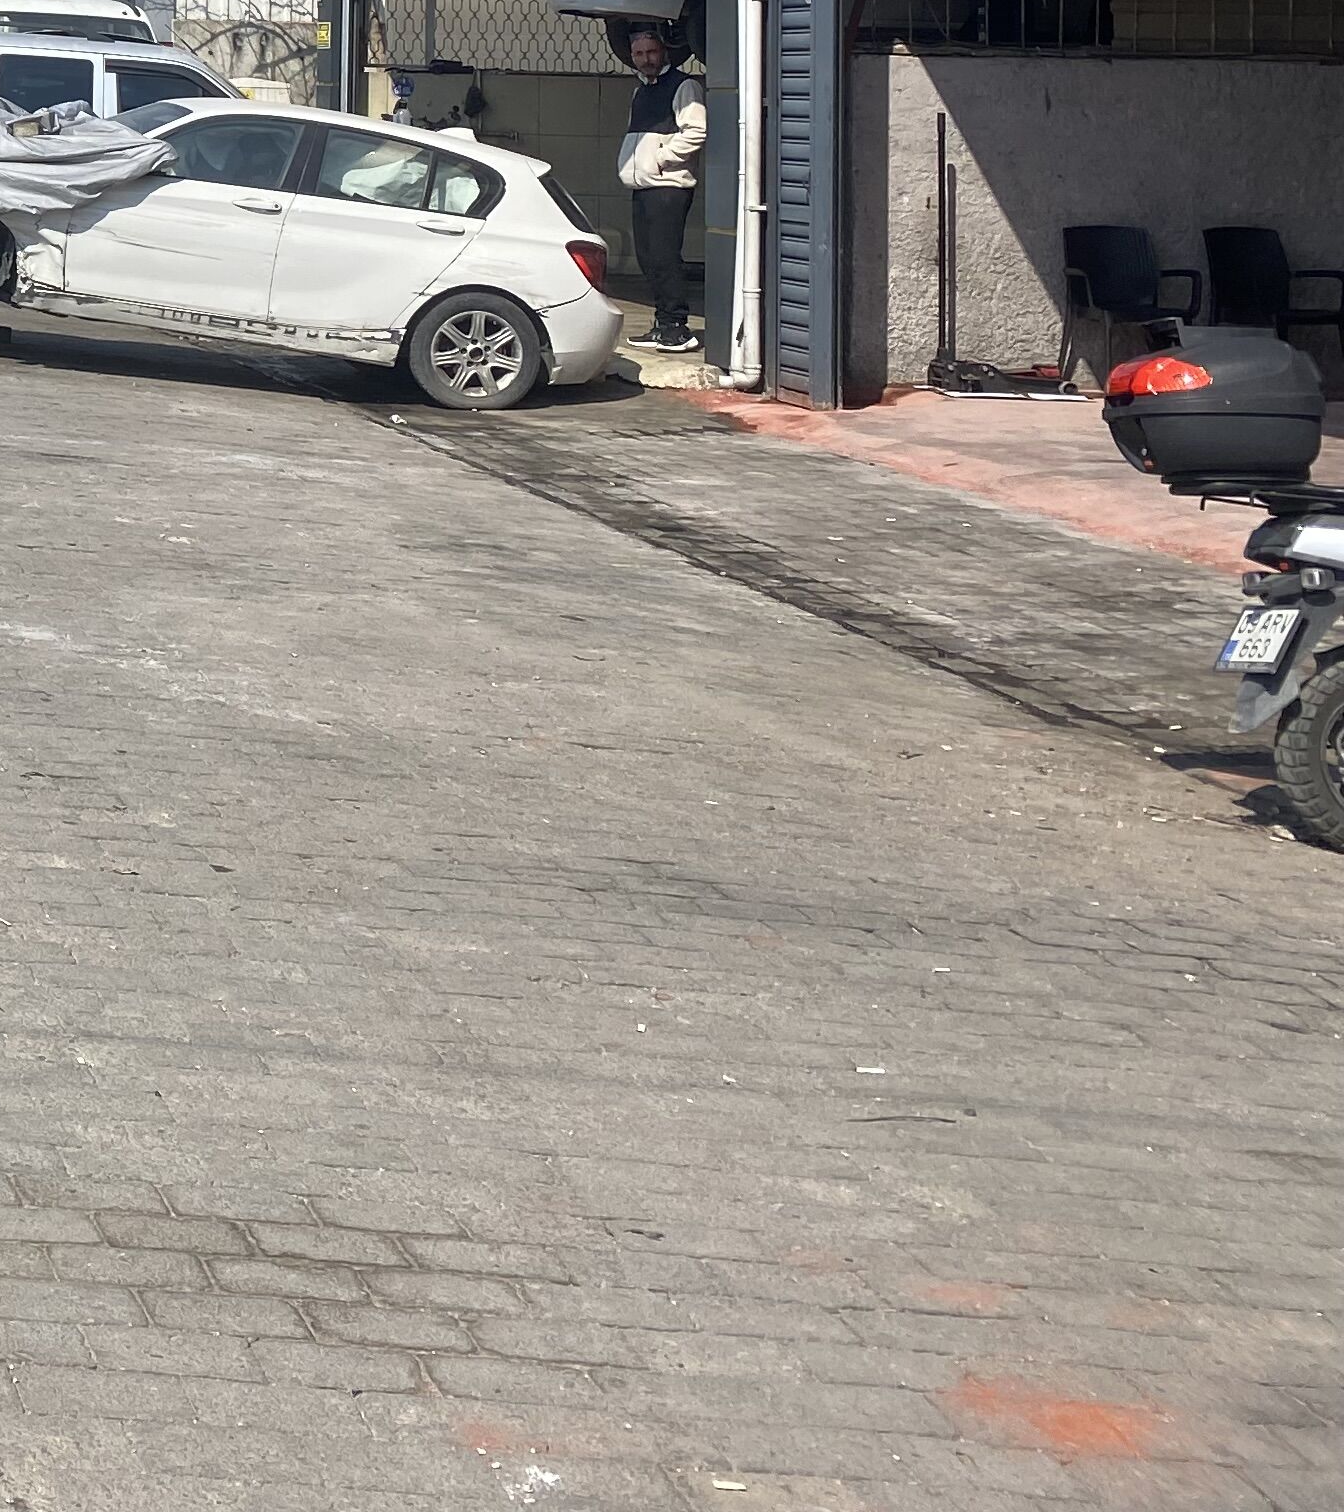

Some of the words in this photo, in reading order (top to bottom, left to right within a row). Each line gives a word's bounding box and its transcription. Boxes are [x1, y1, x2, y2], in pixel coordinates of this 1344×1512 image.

[1237, 613, 1260, 634] 09
[1260, 613, 1296, 634] ARV
[1238, 638, 1272, 659] 663
